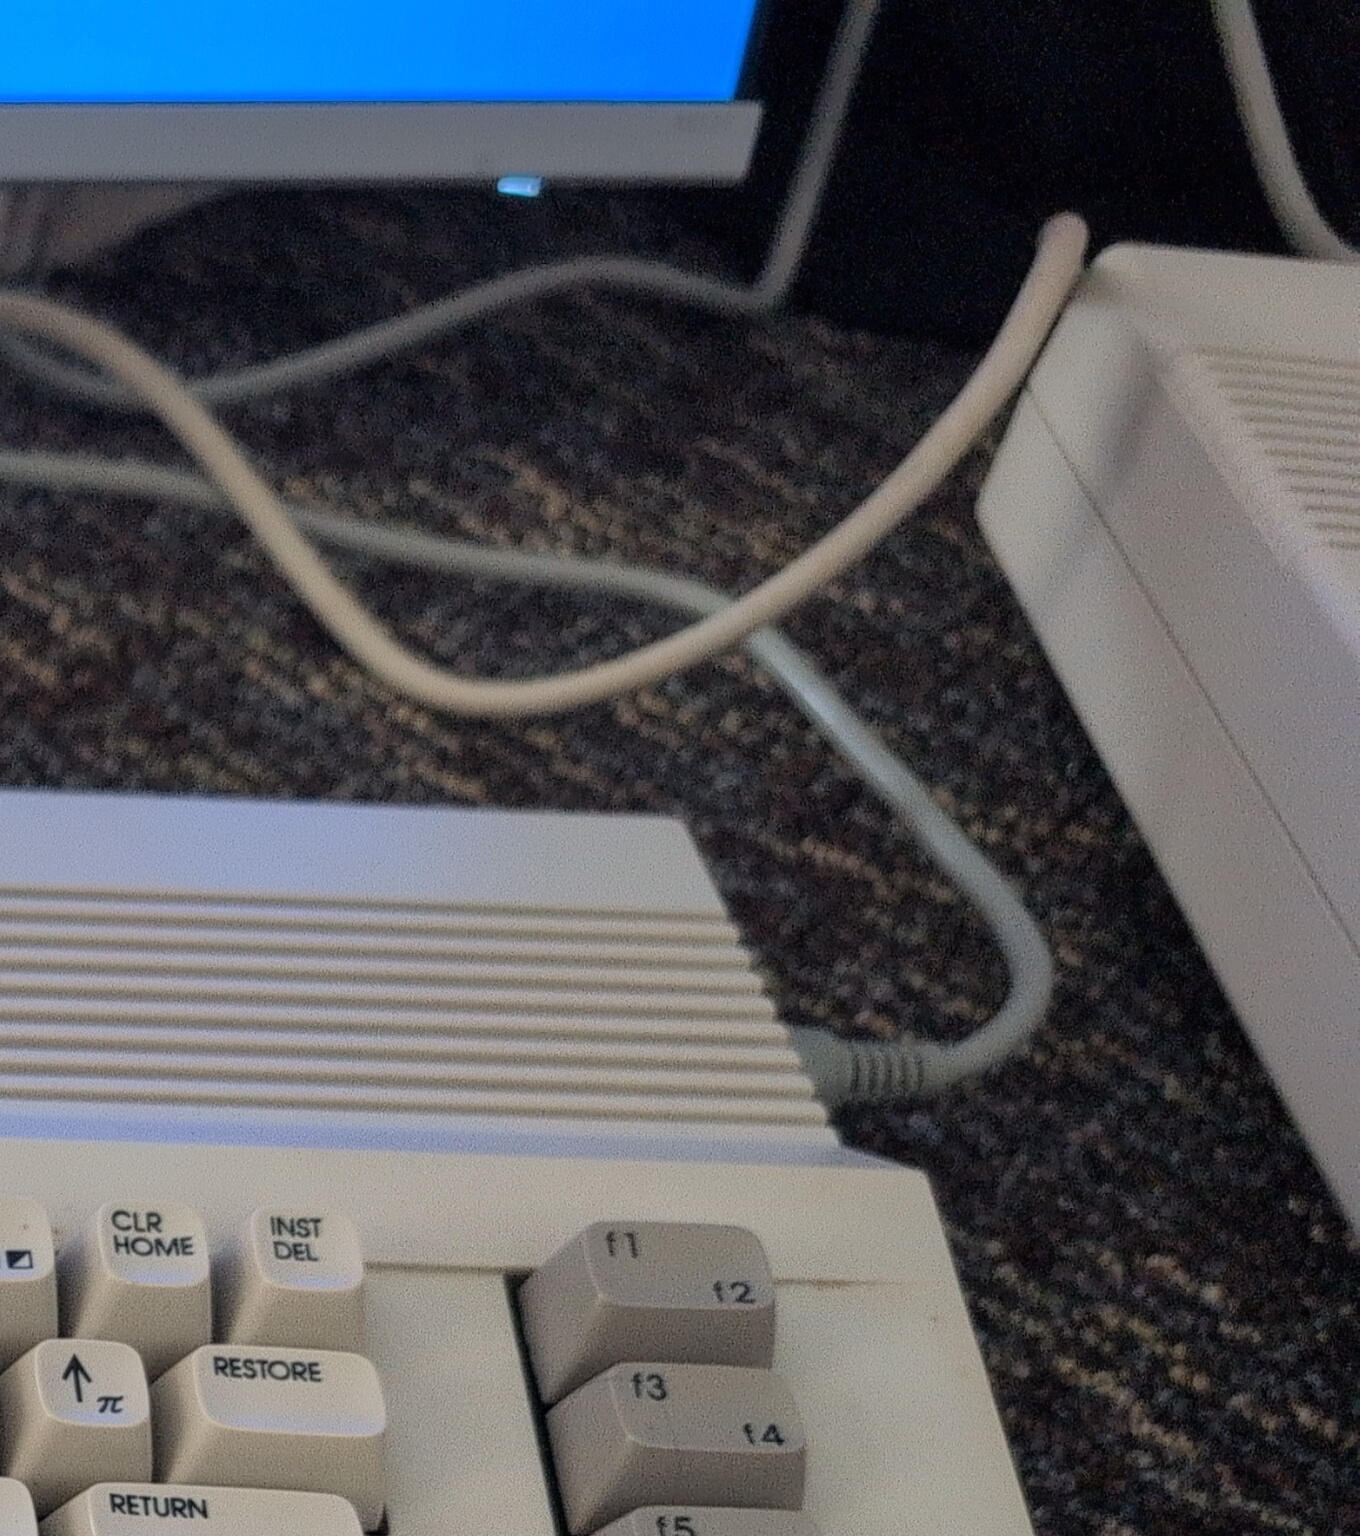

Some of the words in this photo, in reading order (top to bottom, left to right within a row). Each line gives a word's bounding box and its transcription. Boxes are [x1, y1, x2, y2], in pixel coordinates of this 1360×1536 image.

[111, 1209, 163, 1233] CLR
[270, 1216, 322, 1239] INST
[113, 1235, 193, 1257] HOME
[273, 1240, 319, 1262] DEL
[213, 1355, 322, 1383] RESTORE
[109, 1493, 209, 1519] RETURN
